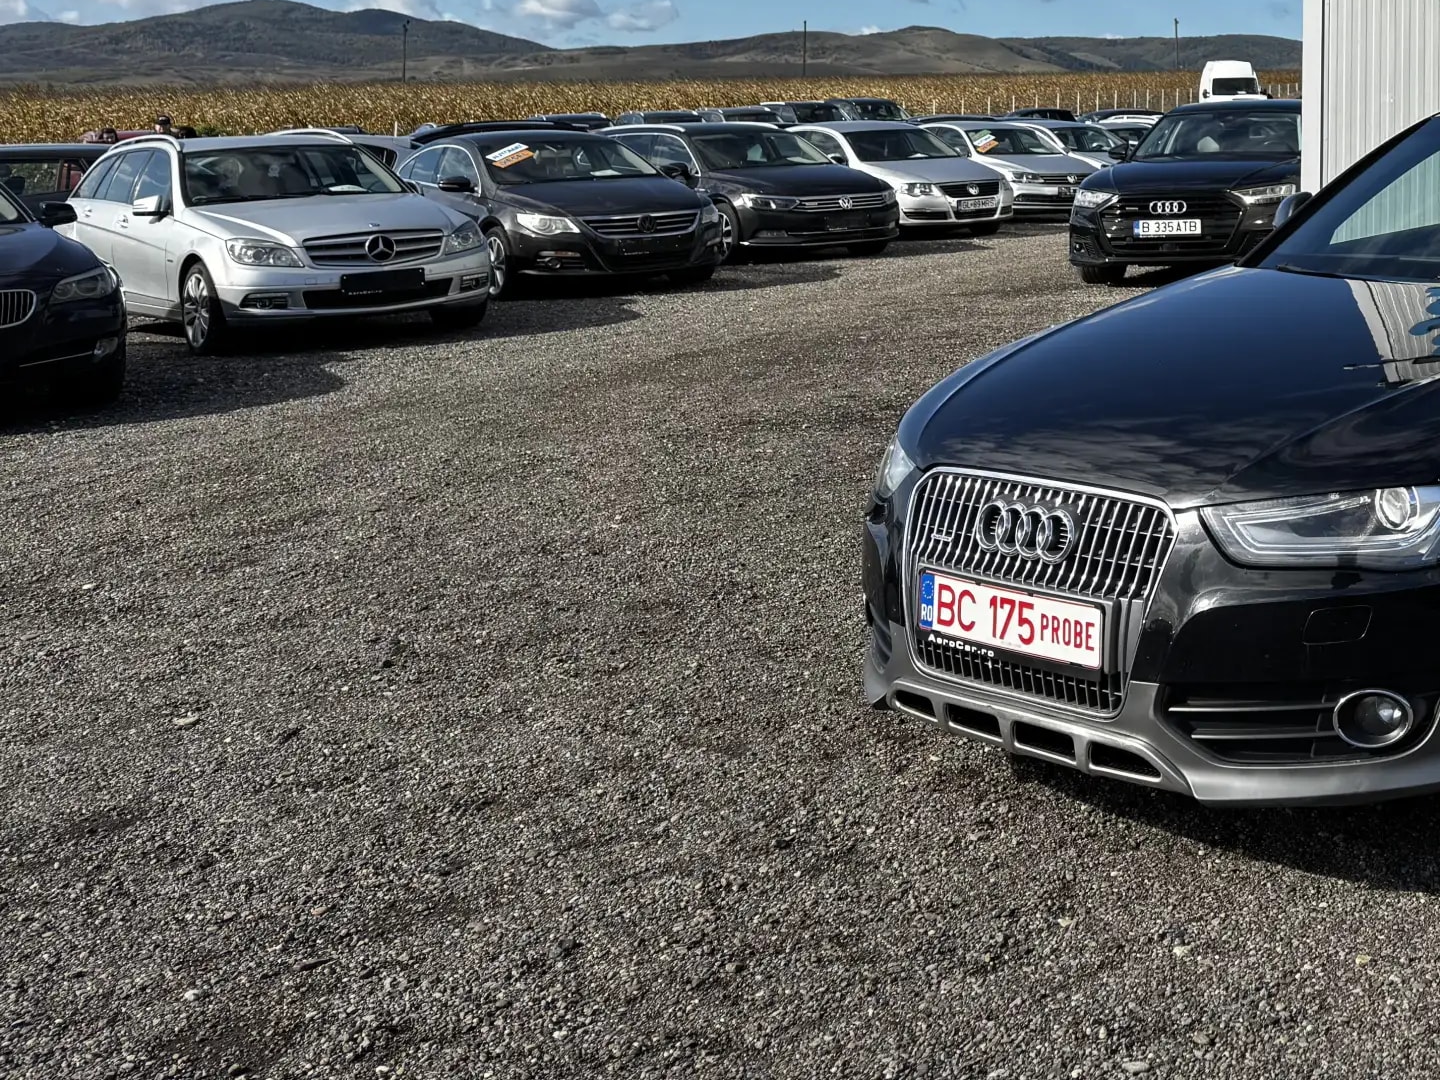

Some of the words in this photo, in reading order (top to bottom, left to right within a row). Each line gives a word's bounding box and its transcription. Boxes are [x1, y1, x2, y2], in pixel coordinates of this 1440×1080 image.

[1142, 222, 1150, 232] B
[1154, 221, 1174, 232] 335
[1175, 221, 1197, 232] ATB
[921, 603, 933, 621] RO
[936, 583, 977, 632] BC
[989, 595, 1035, 646] 175
[1040, 613, 1095, 652] PROBE
[928, 633, 995, 658] AeroCar.ro
